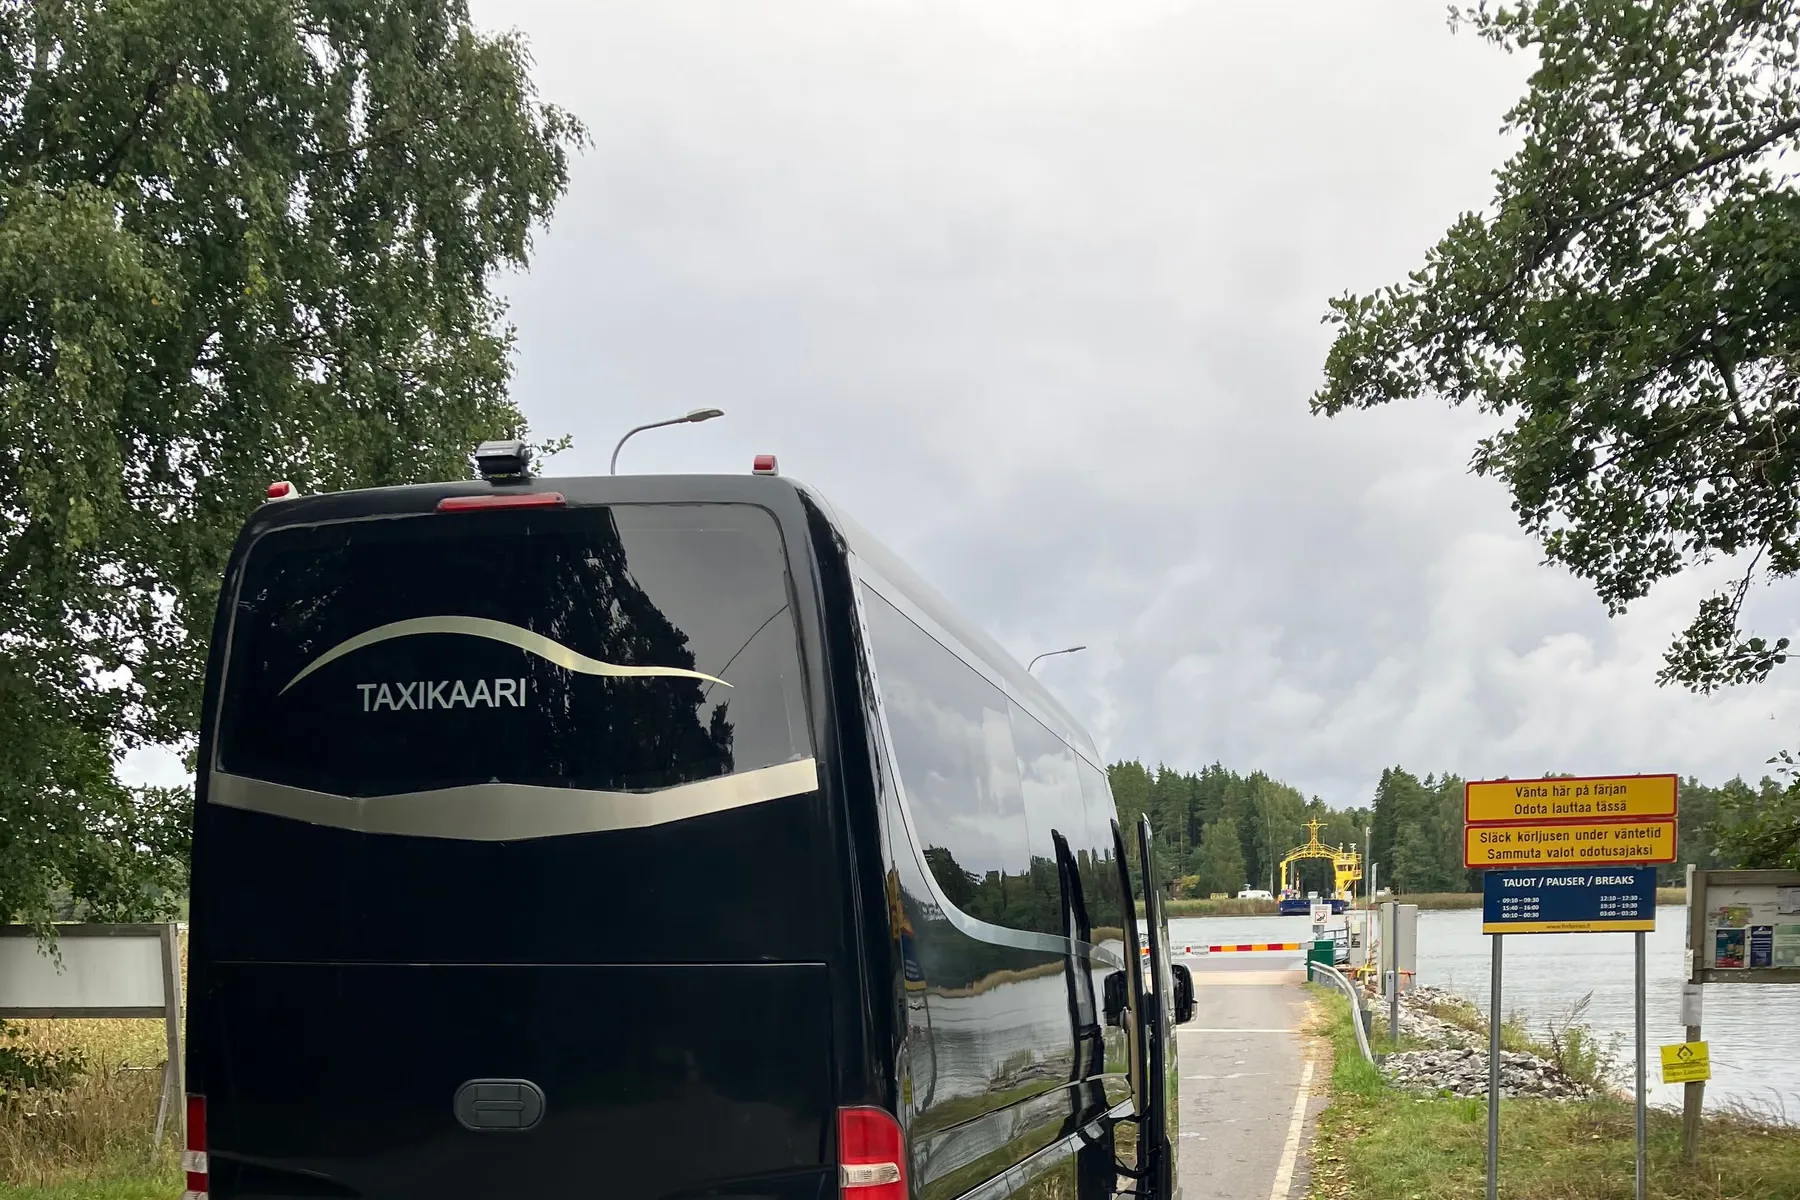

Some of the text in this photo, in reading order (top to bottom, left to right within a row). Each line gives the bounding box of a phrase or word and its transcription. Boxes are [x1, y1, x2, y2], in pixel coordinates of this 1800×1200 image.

[356, 678, 526, 712] TAXIKAARI
[1515, 783, 1627, 798] Vänta här på färjan
[1514, 800, 1627, 815] Odota lauttaa tässä
[1480, 827, 1661, 844] Släck körljusen under väntetid
[1487, 844, 1653, 860] Sammuta valot odotusajaksi
[1503, 875, 1635, 888] TAUOT / PAUSER / BREAKS
